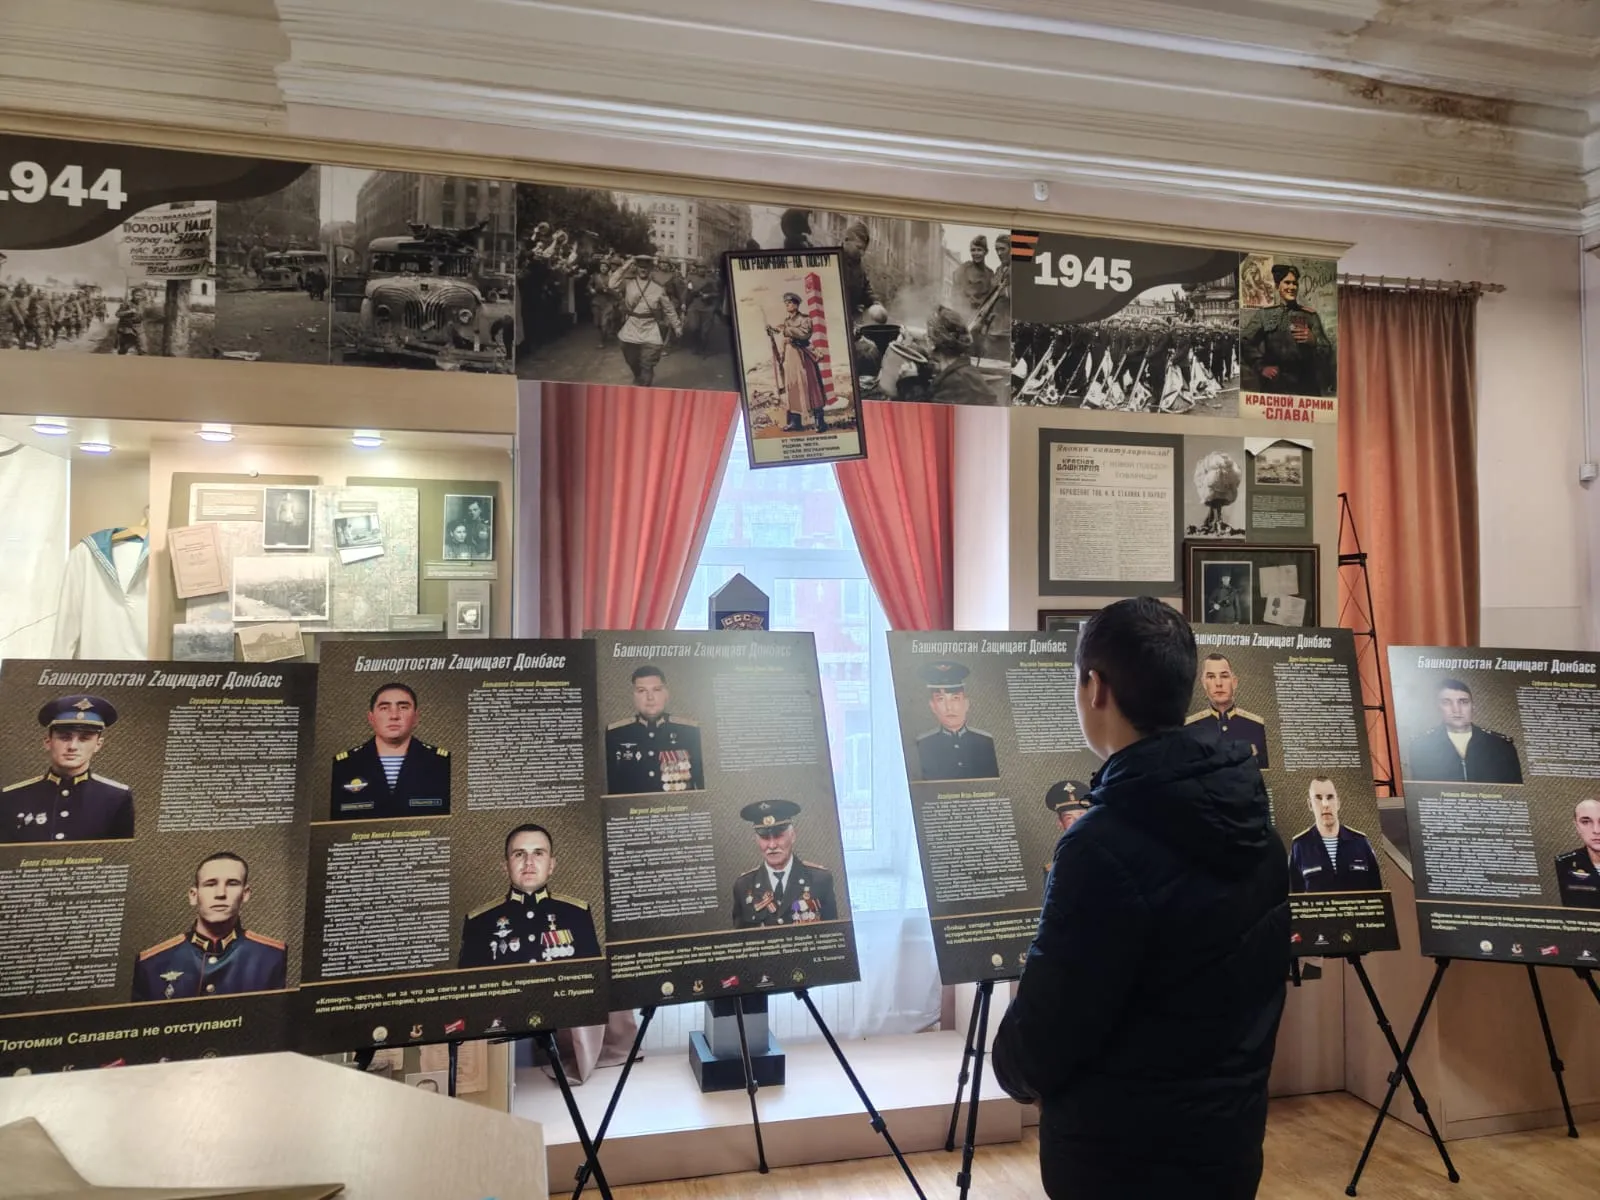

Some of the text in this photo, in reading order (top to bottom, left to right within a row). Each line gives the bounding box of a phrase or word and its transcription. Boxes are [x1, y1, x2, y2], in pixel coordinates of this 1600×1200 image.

[123, 221, 179, 235] ПОЛОЦК
[1033, 251, 1133, 293] 1945
[1245, 394, 1334, 411] КРАСНОЙ АРМИИ
[912, 639, 979, 656] Башкортостан
[1029, 638, 1067, 656] Донбасс
[1296, 633, 1332, 650] Донбасс
[613, 642, 692, 660] Башкортостан
[354, 655, 446, 674] Башкортостан
[513, 652, 566, 671] Донбасс
[1417, 655, 1493, 671] Башкортостан
[1550, 659, 1597, 674] Донбасс
[37, 668, 146, 689] Башкортостан
[222, 671, 283, 690] Донбасс
[0, 1015, 244, 1051] Потомки Салавата не отступают!
